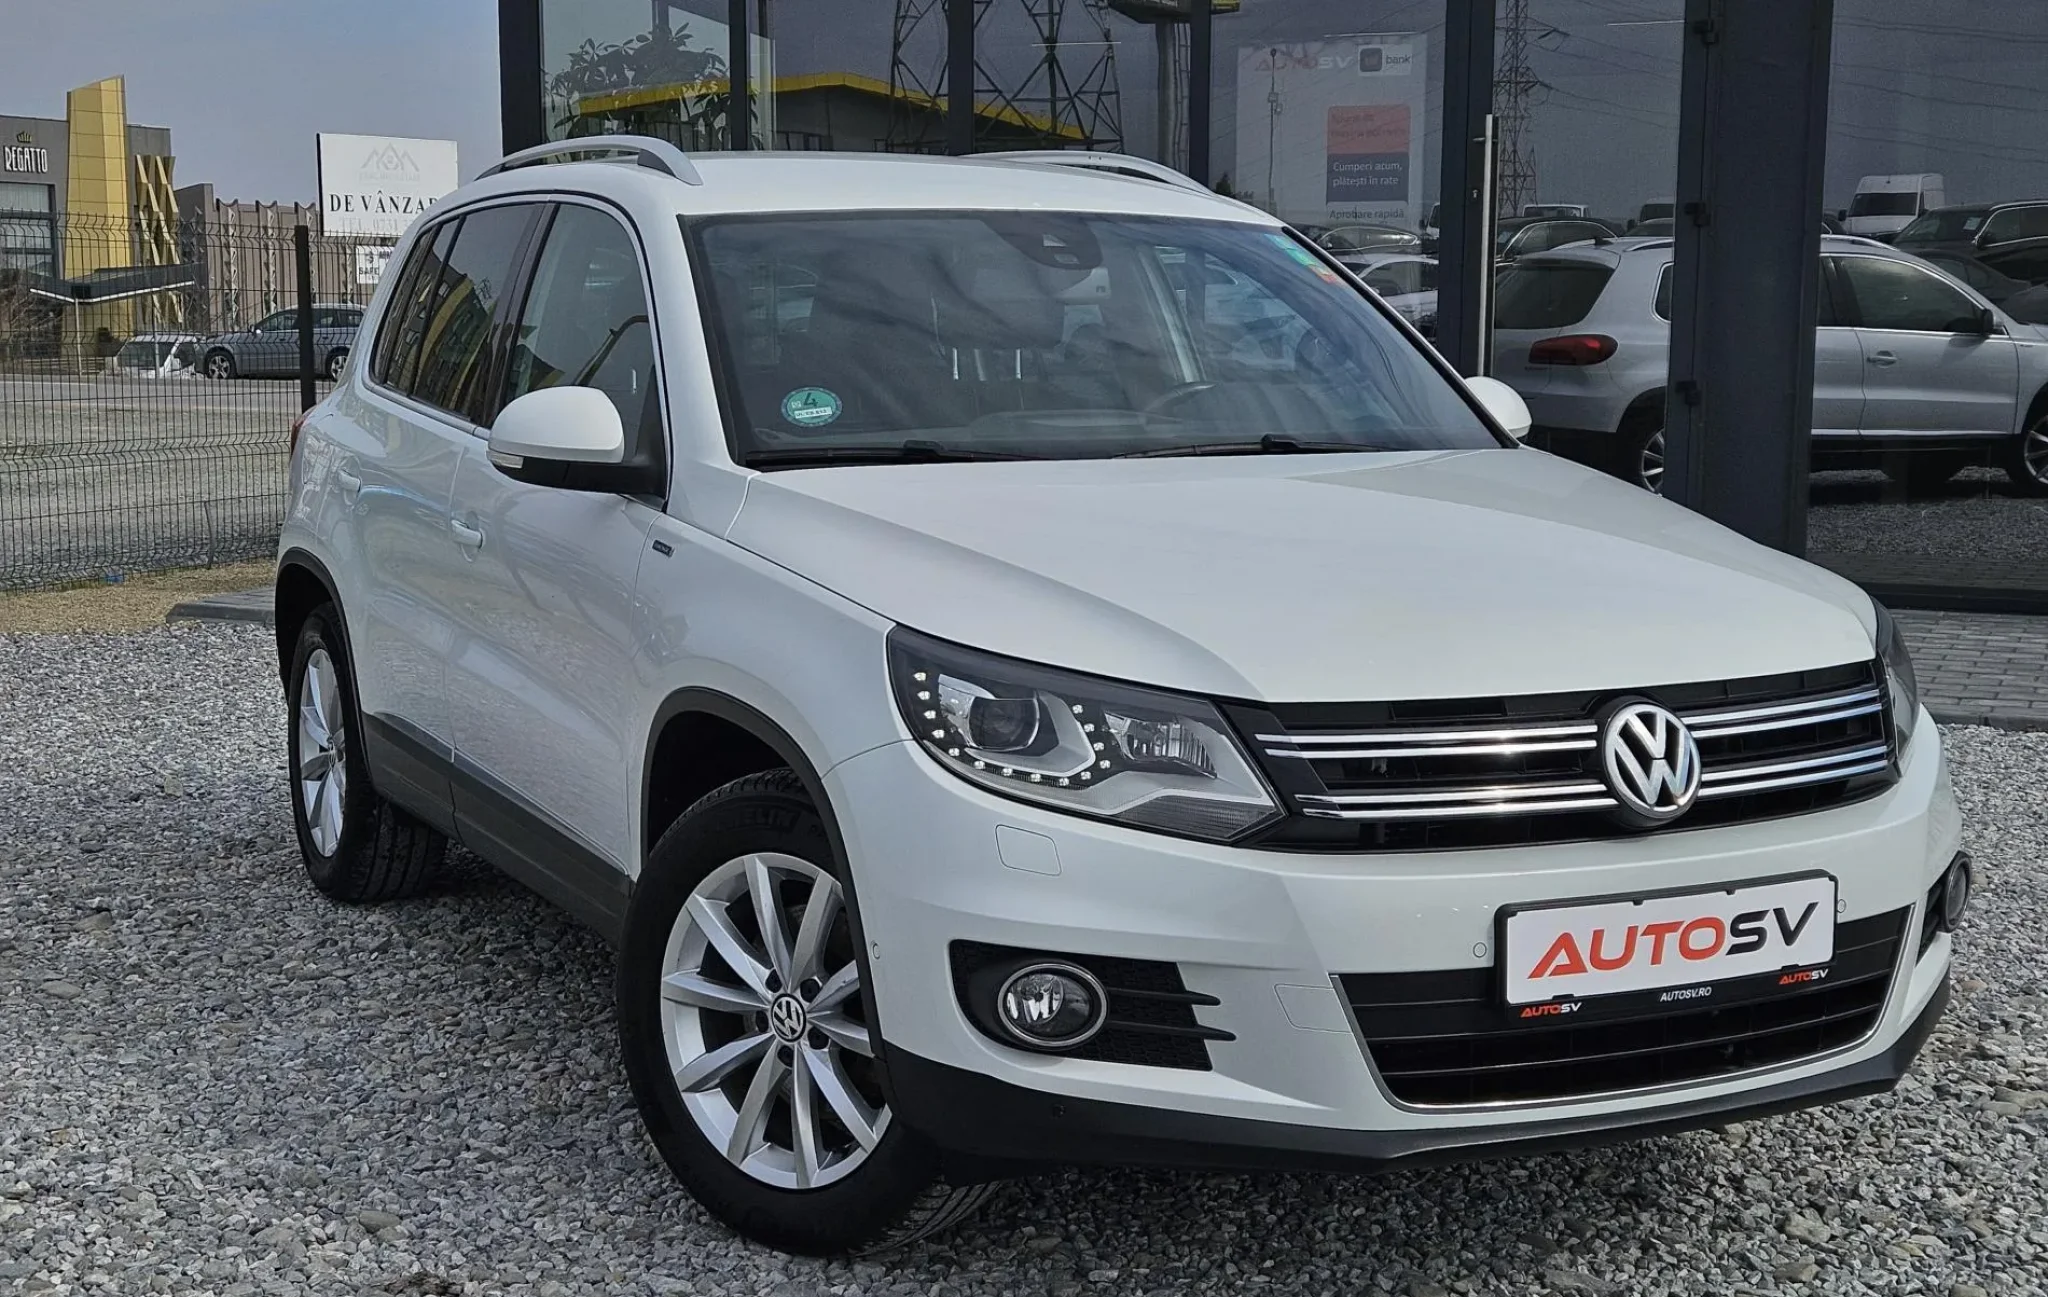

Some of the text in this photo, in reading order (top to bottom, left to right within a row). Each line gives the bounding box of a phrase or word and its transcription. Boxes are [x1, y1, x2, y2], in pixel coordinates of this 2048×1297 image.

[1385, 54, 1411, 65] bank
[4, 146, 48, 173] REGATTO
[329, 193, 355, 213] DE
[803, 392, 819, 407] 4
[1526, 901, 1819, 979] AUTOSV
[1779, 968, 1829, 985] AUTOSV
[1659, 986, 1712, 1003] AUTOSV.RO
[1520, 1002, 1582, 1018] AUTOSV
